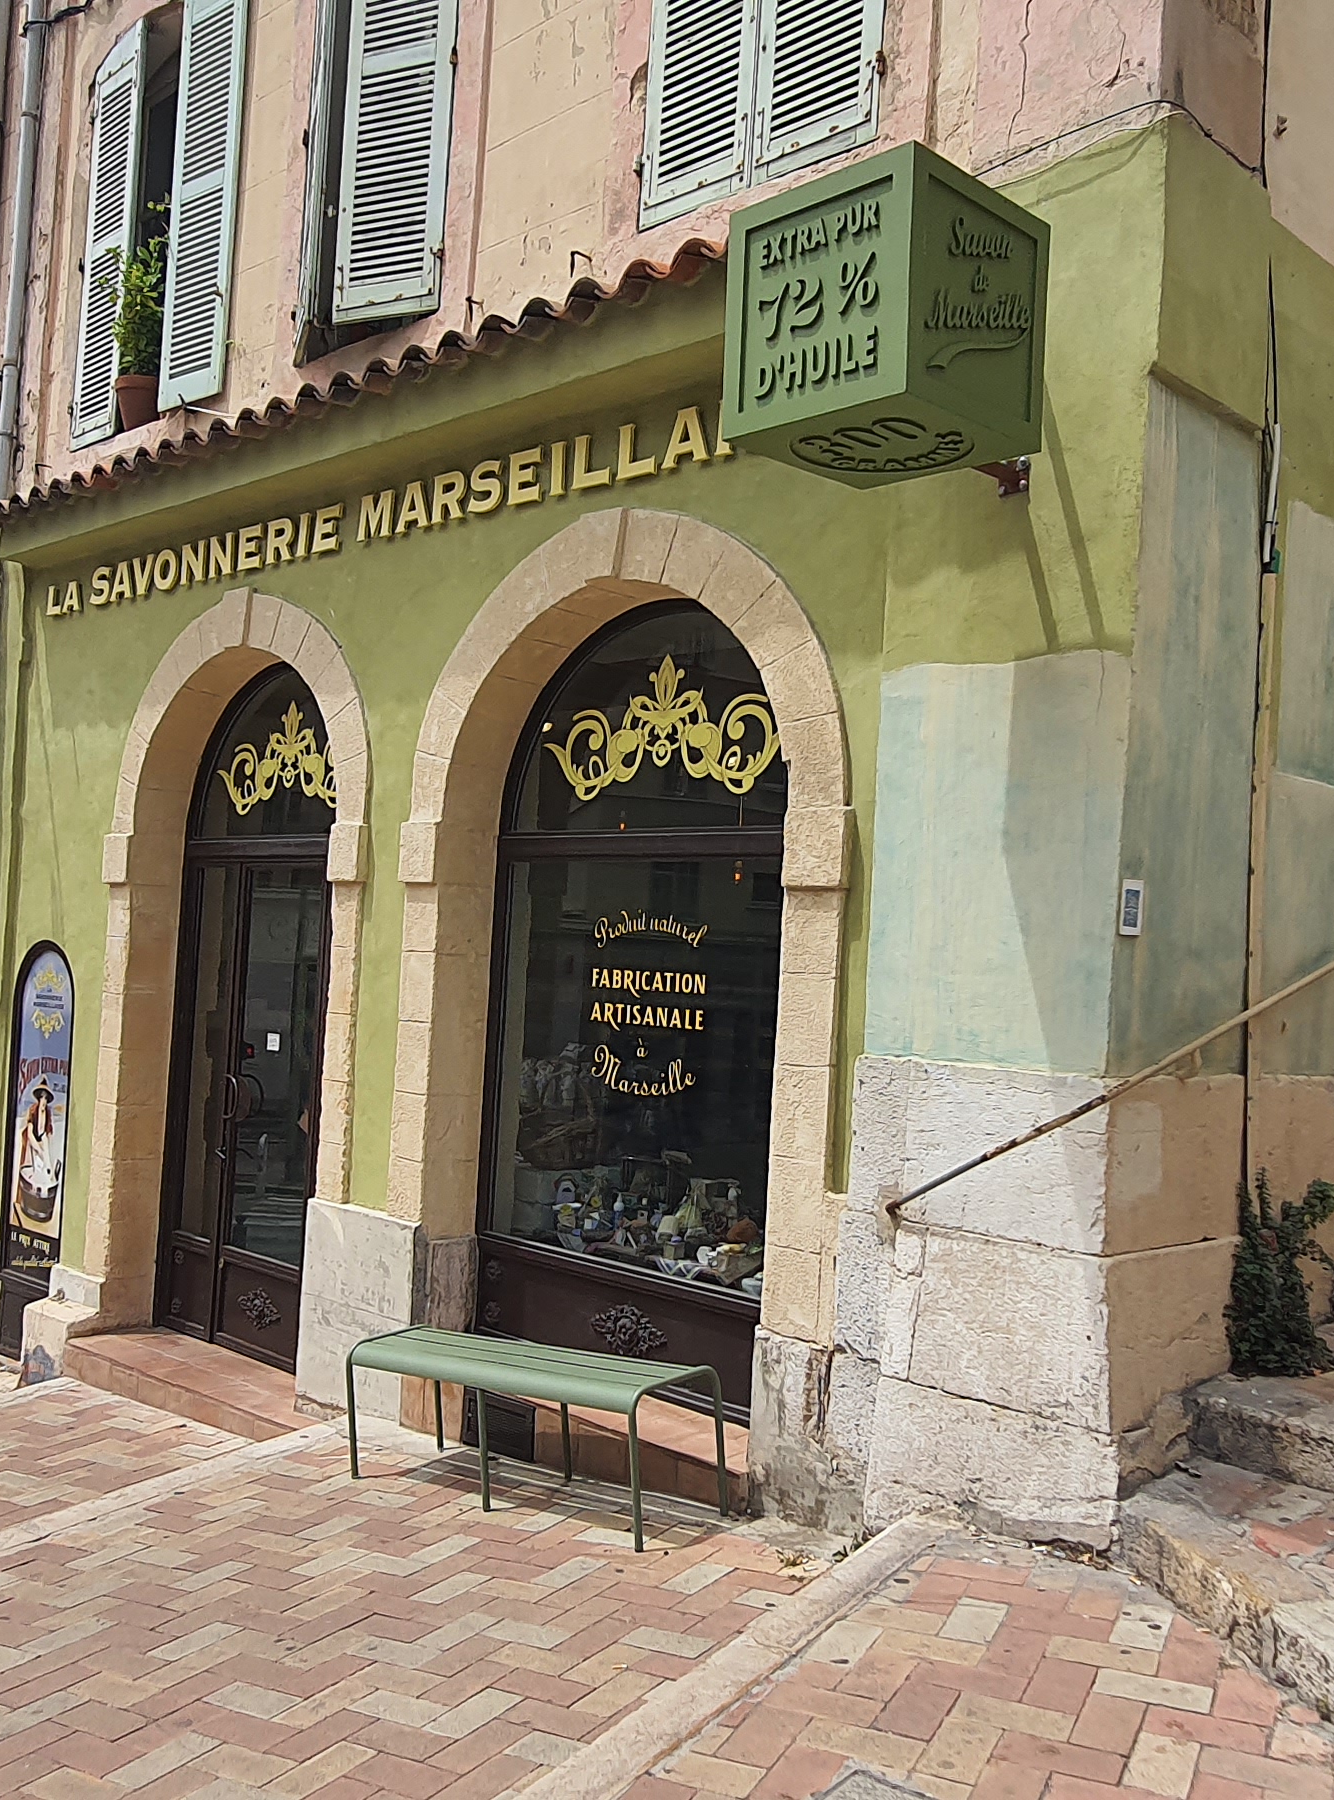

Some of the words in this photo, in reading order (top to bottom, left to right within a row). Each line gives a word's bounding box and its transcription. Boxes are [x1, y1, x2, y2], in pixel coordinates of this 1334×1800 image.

[759, 217, 829, 272] EXTRA
[835, 201, 882, 243] PUR
[949, 216, 1013, 260] Savon
[758, 277, 824, 341] 72
[838, 251, 881, 316] %
[924, 287, 1032, 332] Marseille
[754, 325, 881, 400] D'HUILE
[798, 417, 928, 457] 300
[830, 430, 965, 470] GRAMMES
[46, 581, 83, 616] LA
[89, 502, 345, 606] SAVONNERIE
[594, 909, 646, 949] Produit
[649, 914, 709, 948] naturel
[591, 968, 707, 998] FABRICATION
[590, 1001, 704, 1031] ARTISANALE
[591, 1044, 696, 1096] Marseille
[636, 1038, 649, 1058] à
